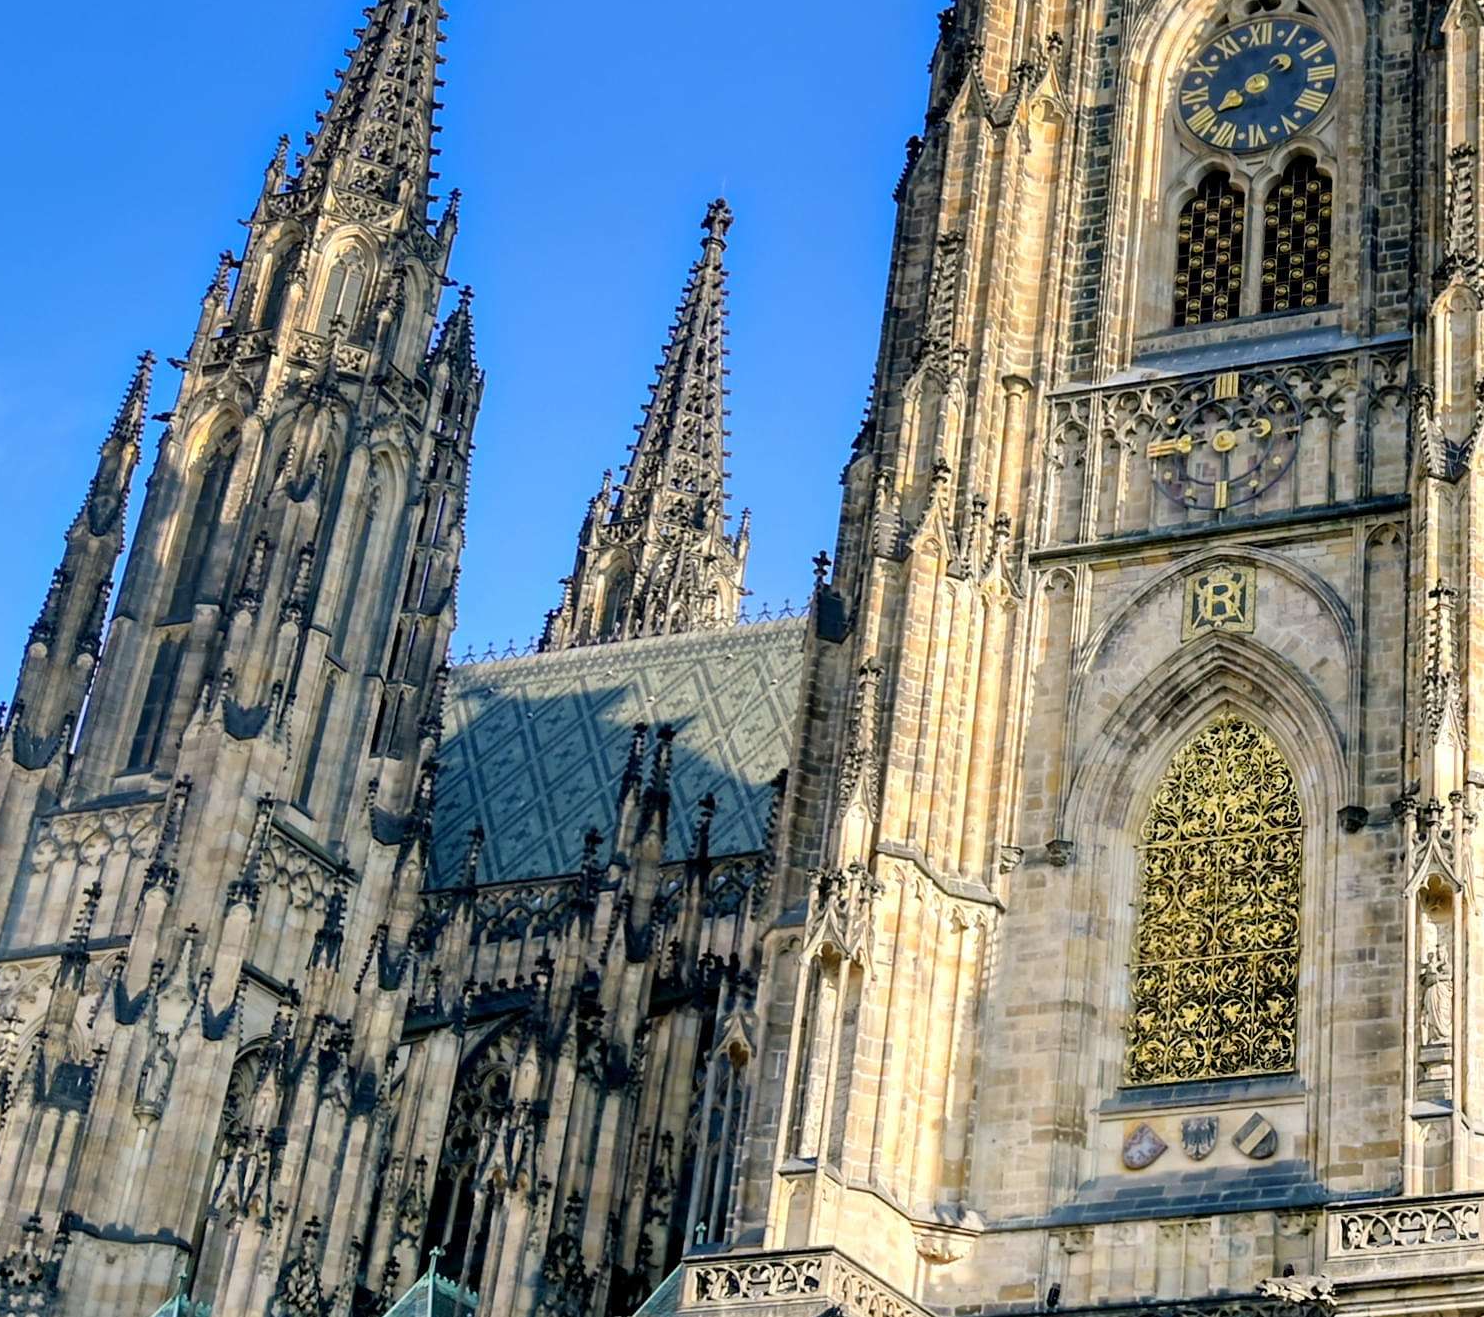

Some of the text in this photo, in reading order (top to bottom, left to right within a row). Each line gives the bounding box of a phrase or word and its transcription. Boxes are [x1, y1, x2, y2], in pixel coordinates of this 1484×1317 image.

[1214, 34, 1242, 60] XI
[1248, 22, 1273, 47] XII
[1299, 39, 1327, 60] II
[1190, 60, 1220, 78] X
[1307, 64, 1335, 82] III
[1181, 85, 1209, 106] IX
[1294, 88, 1329, 113] IIII
[1186, 105, 1218, 137] VIII
[1280, 114, 1300, 135] V
[1210, 121, 1237, 148] VII
[1248, 123, 1268, 148] VI
